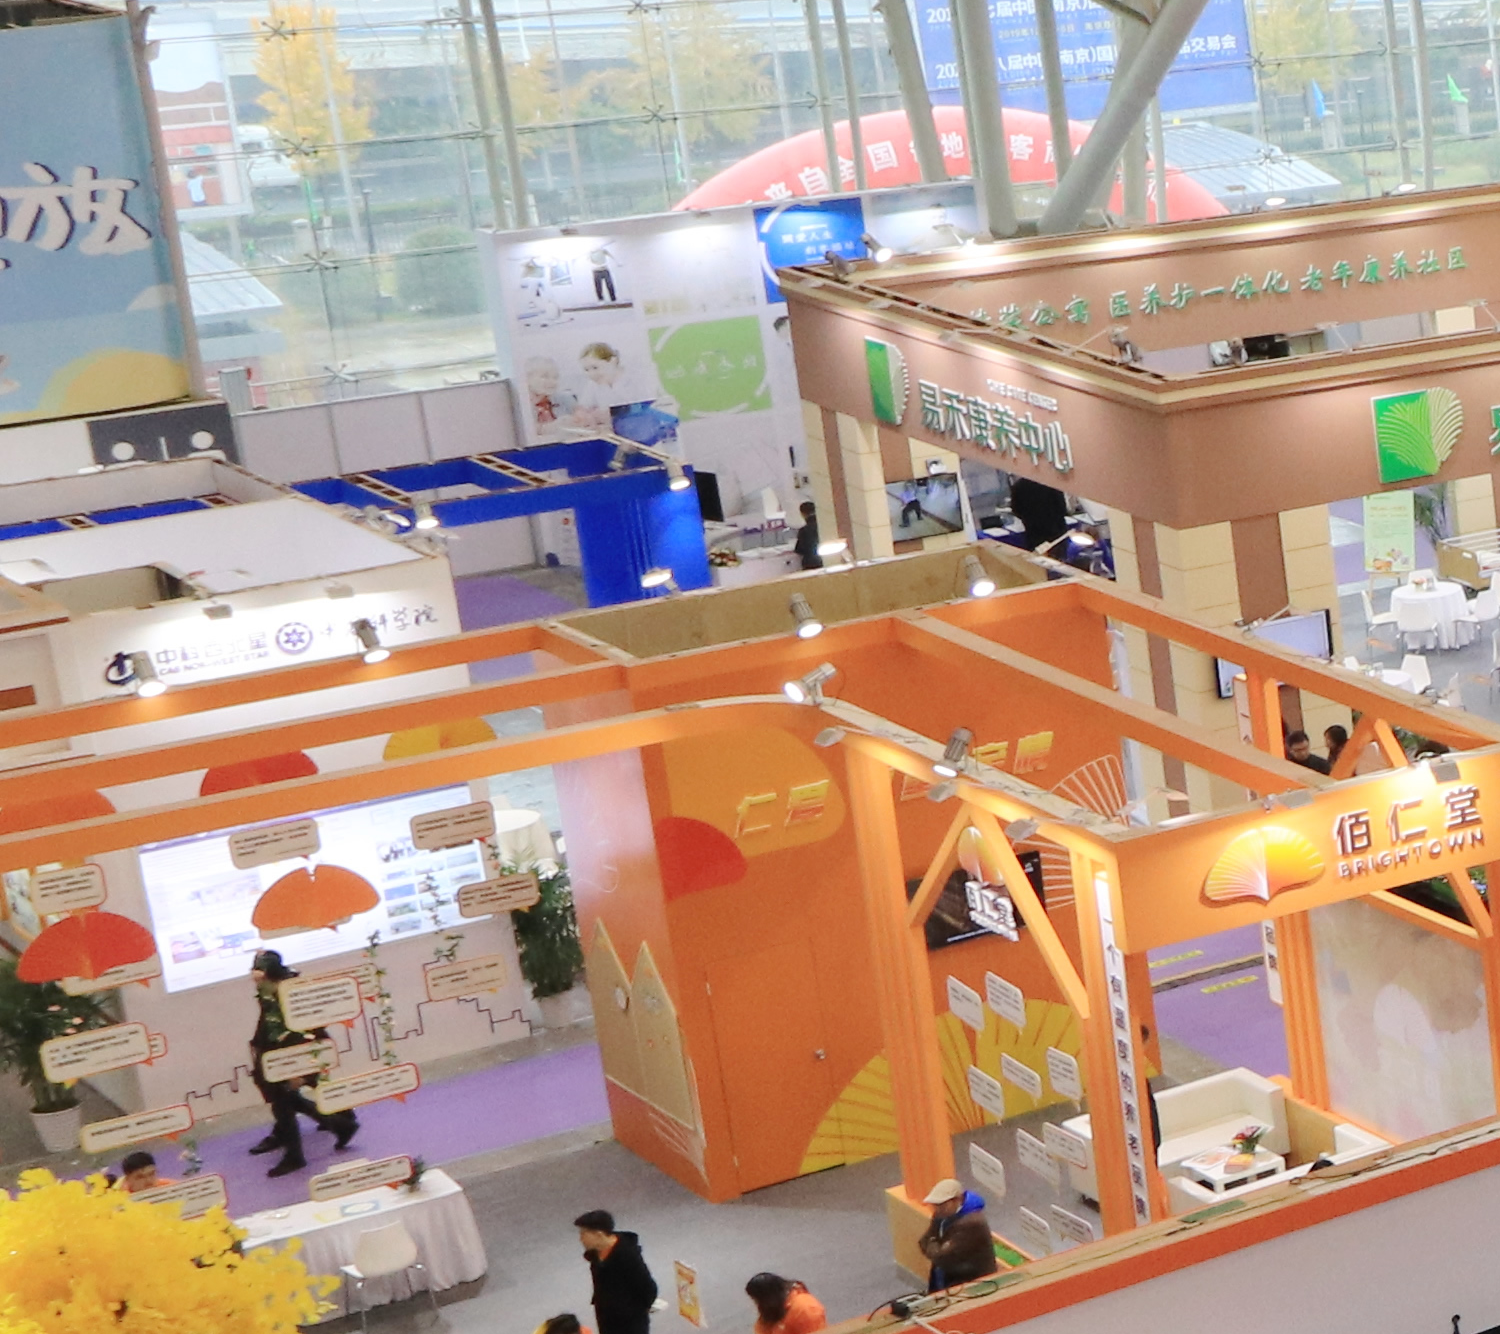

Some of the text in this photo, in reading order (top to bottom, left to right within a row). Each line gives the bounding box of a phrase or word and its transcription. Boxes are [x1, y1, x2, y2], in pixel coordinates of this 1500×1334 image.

[1109, 269, 1291, 319] 医养护一体化
[1299, 245, 1469, 293] 老年康养社区
[918, 377, 1075, 475] 易禾康养中心
[1334, 785, 1483, 857] 佰仁堂
[1337, 828, 1486, 880] BRIGHTOWN
